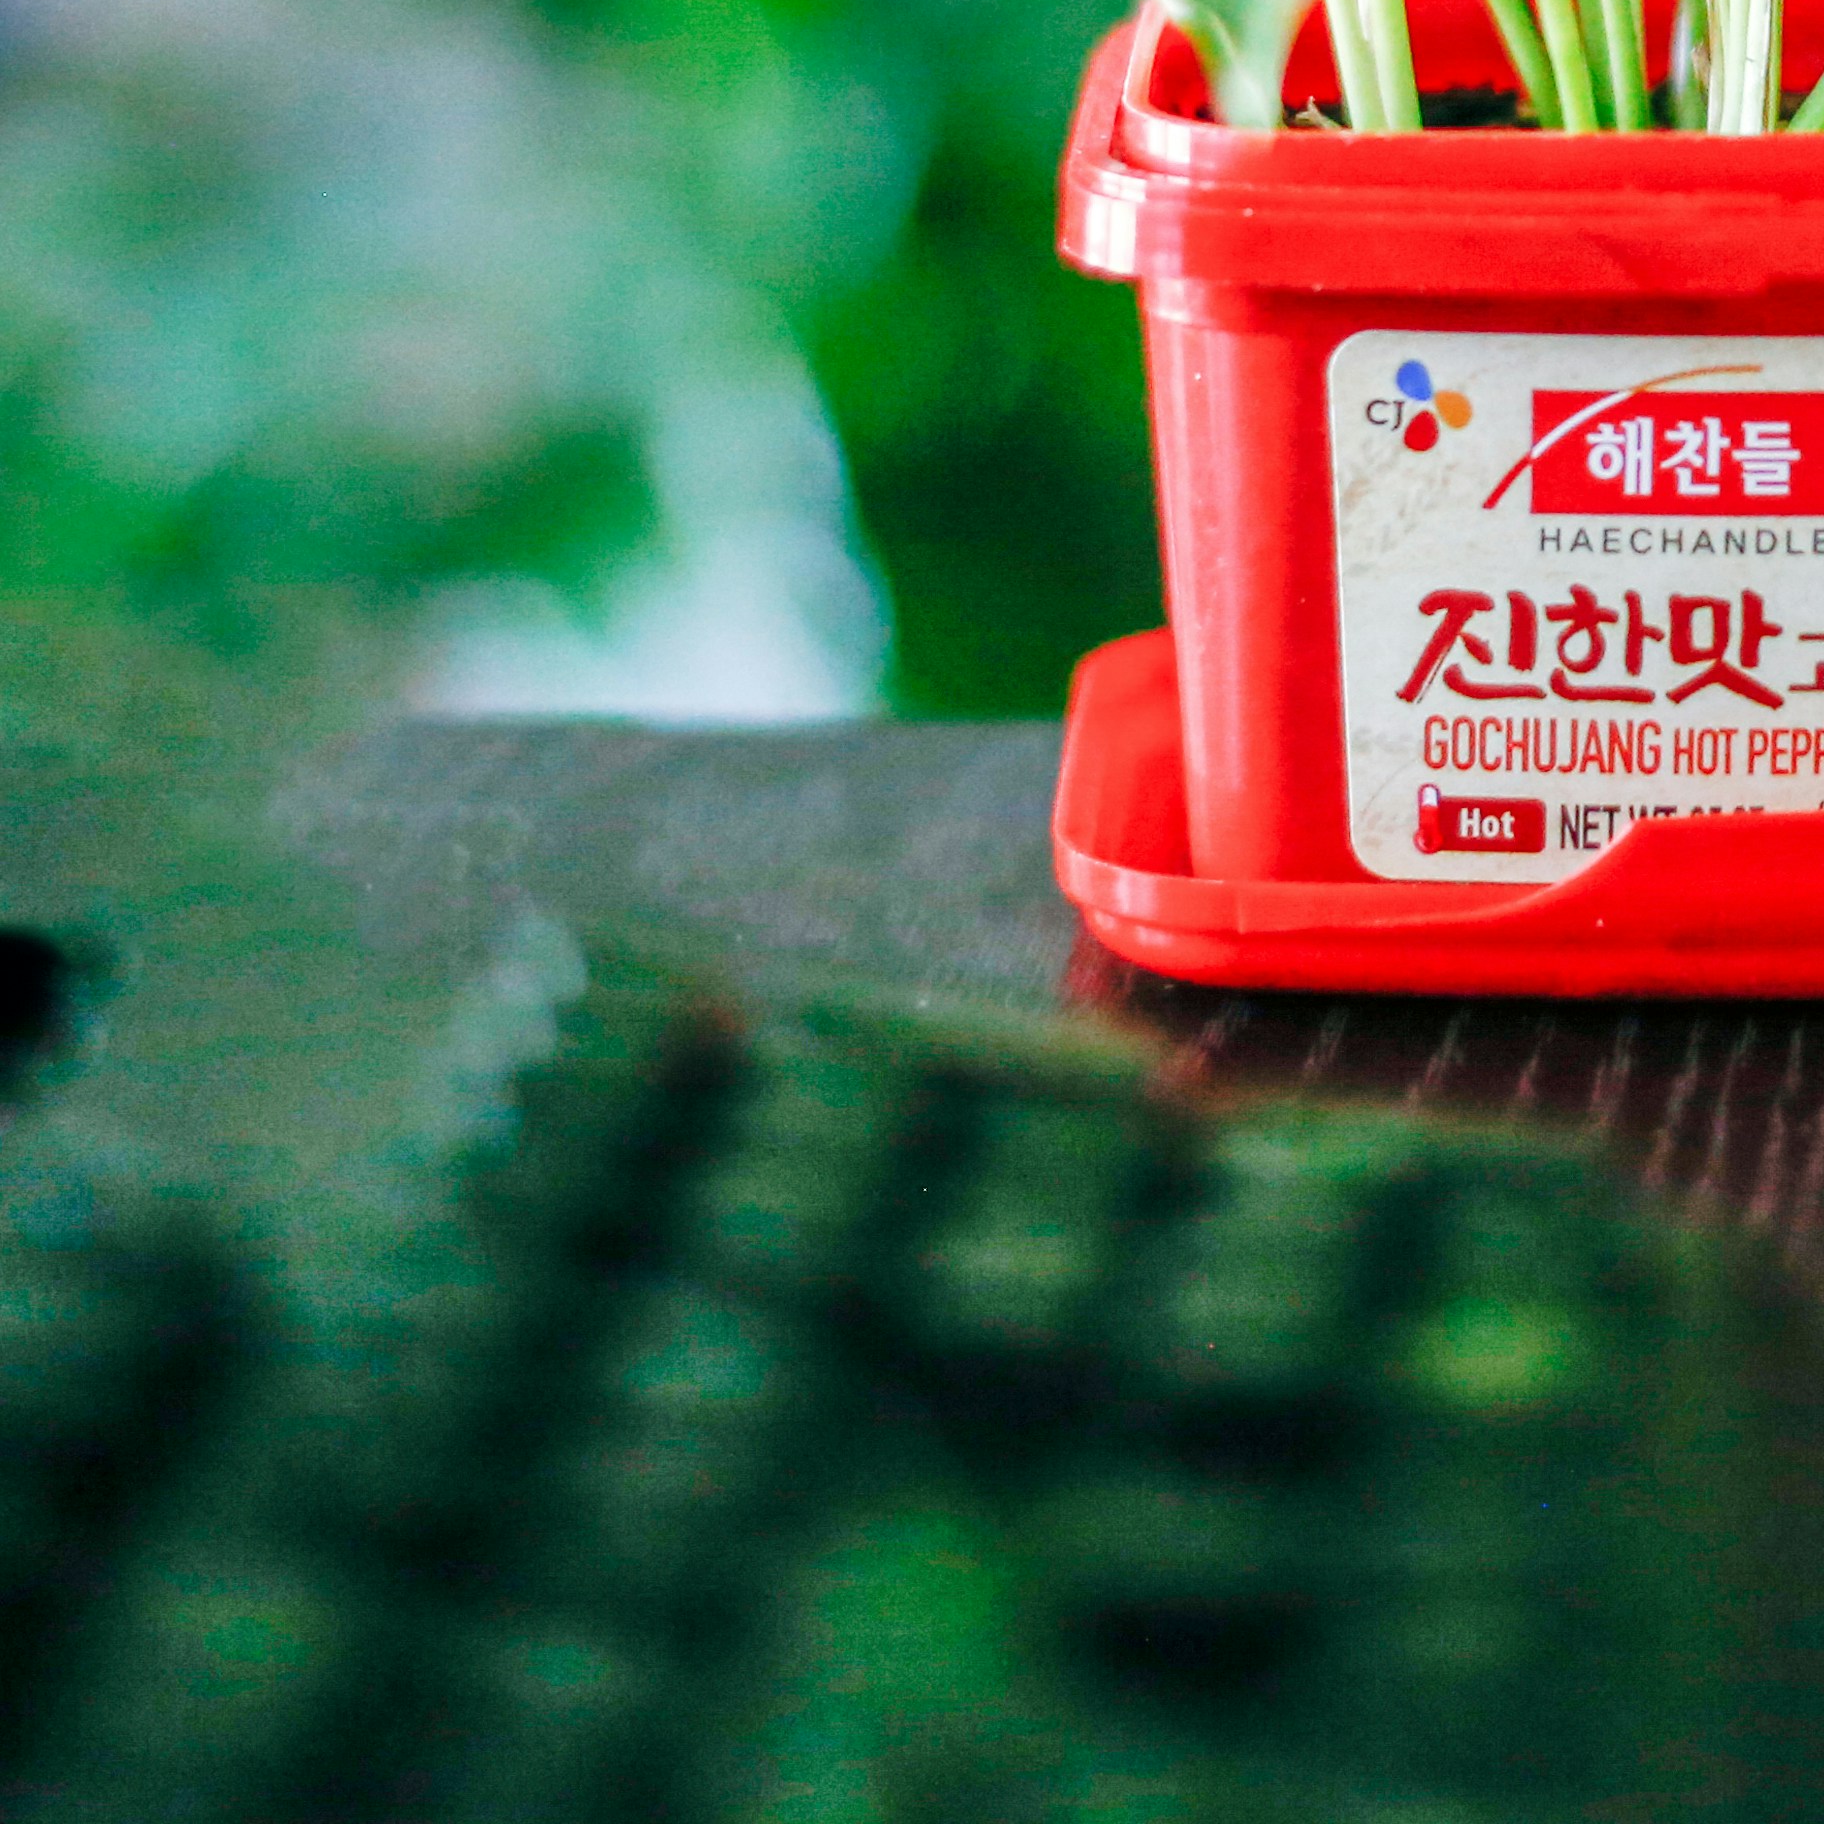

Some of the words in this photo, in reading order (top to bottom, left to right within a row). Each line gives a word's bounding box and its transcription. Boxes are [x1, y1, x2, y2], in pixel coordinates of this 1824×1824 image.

[1366, 399, 1405, 431] CJ
[1586, 415, 1801, 497] 해찬들
[1396, 583, 1785, 710] 진한맛
[1423, 714, 1661, 775] GOCHUJANG
[1673, 727, 1737, 776] HOT
[1459, 807, 1515, 839] Hot
[1560, 804, 1621, 849] NET
